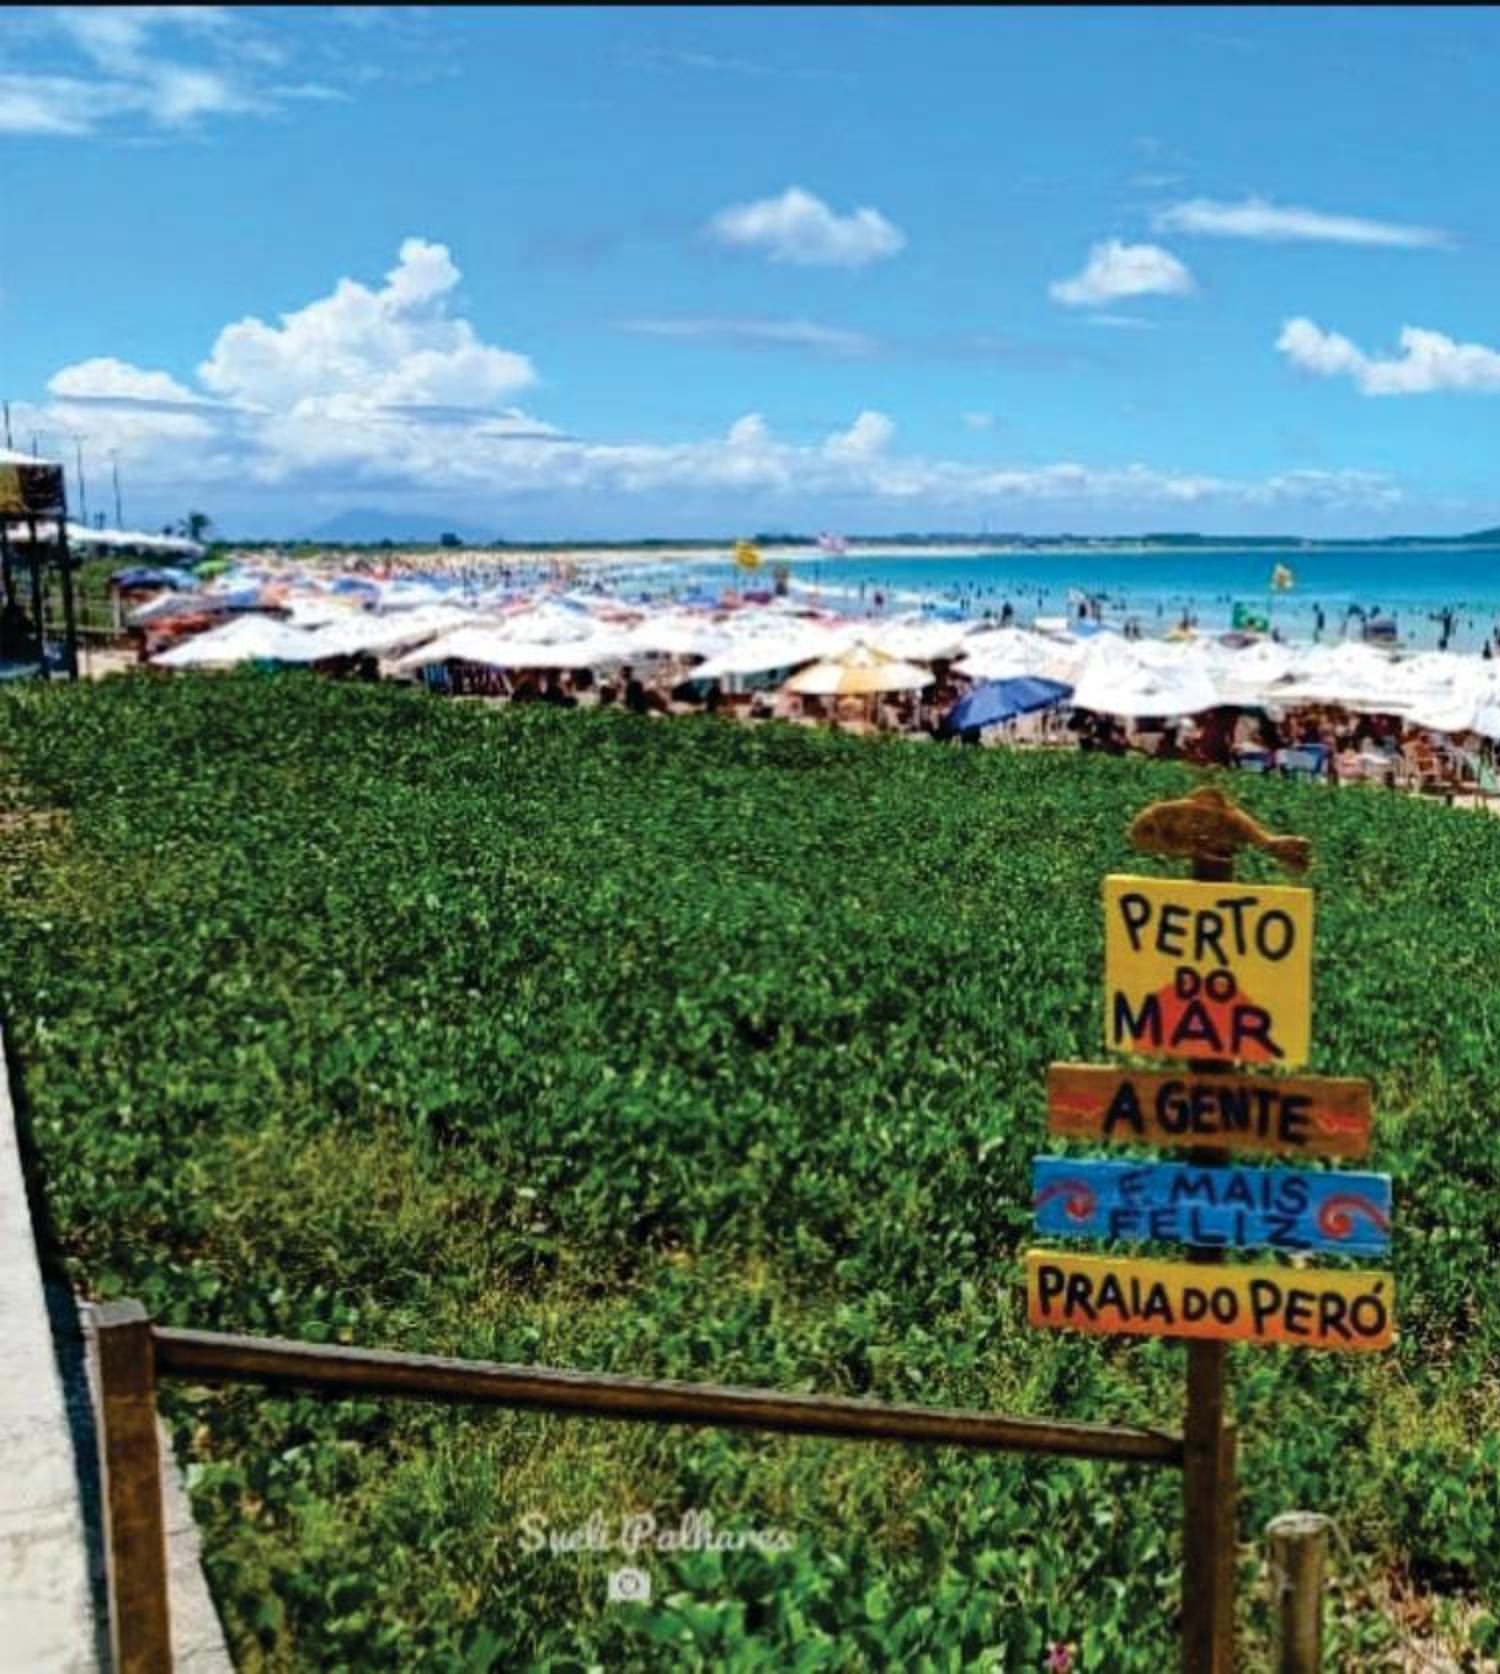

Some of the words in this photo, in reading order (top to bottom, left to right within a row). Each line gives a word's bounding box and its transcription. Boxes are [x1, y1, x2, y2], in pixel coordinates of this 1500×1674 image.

[1120, 893, 1296, 967] PERTO
[1175, 966, 1237, 1003] DO
[1114, 990, 1285, 1058] MAR
[1103, 1080, 1144, 1135] A
[1156, 1080, 1313, 1145] GENTE
[1169, 1172, 1311, 1216] MAIS
[1109, 1207, 1313, 1250] FELIZ
[1038, 1265, 1174, 1325] PRAIA
[1182, 1287, 1239, 1325] DO
[1248, 1279, 1386, 1341] PERÓ
